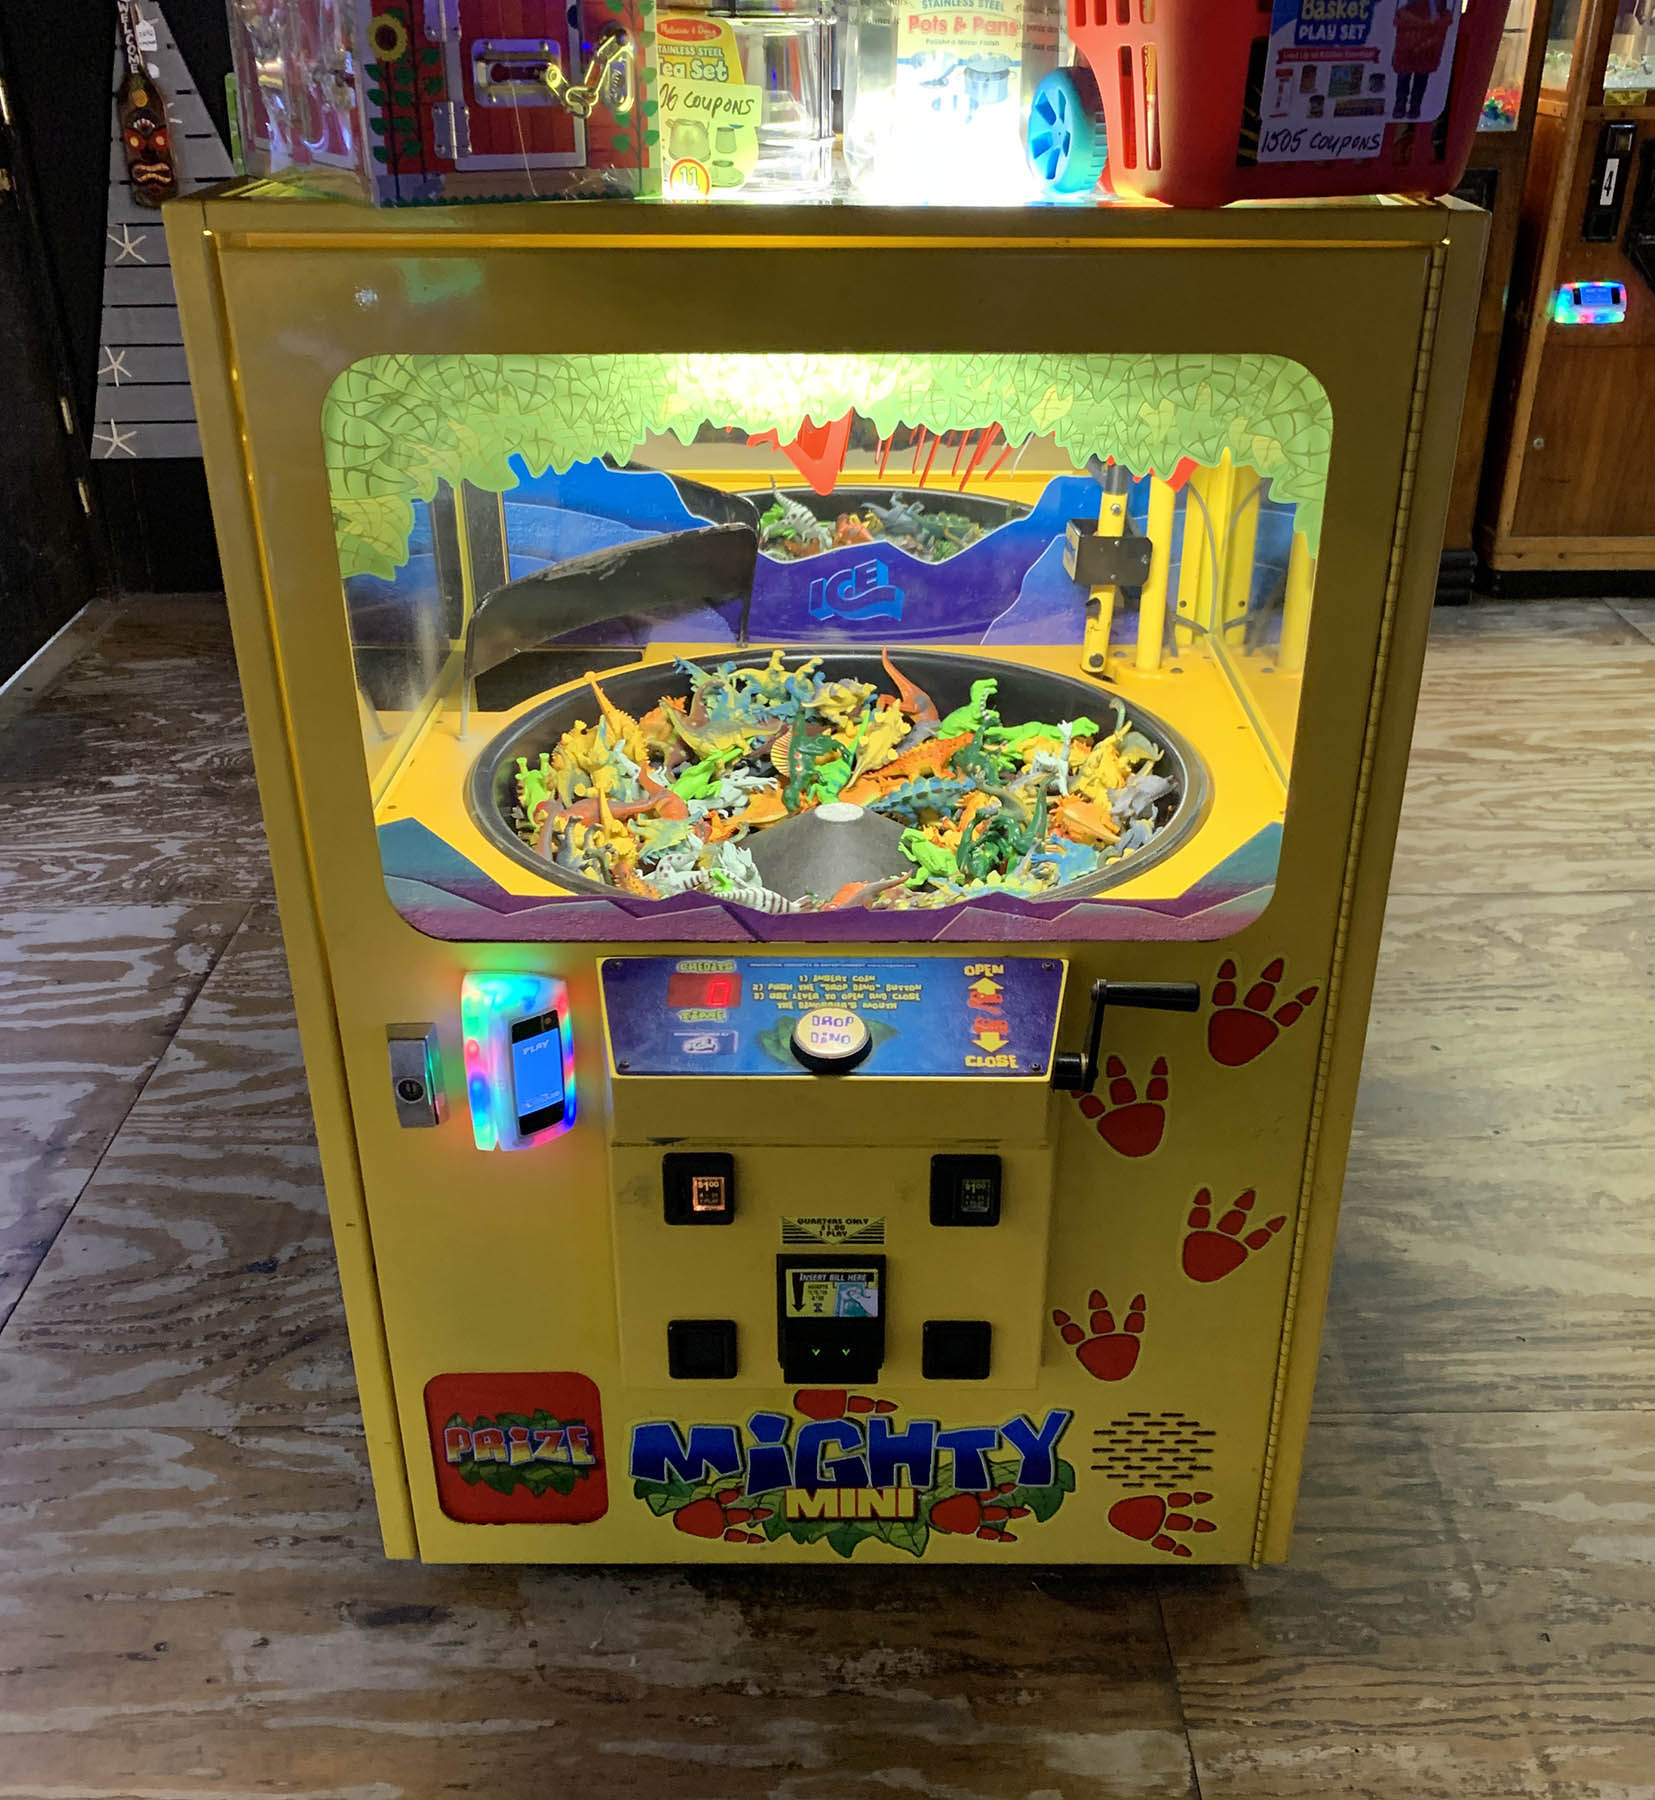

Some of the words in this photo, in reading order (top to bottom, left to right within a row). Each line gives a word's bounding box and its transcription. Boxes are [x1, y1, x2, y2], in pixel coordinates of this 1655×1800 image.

[1301, 0, 1371, 20] Basket
[908, 15, 948, 34] Pots
[953, 15, 966, 33] &
[972, 15, 1018, 36] Pans
[1299, 24, 1337, 41] PLAY
[1339, 23, 1367, 40] SET
[117, 0, 140, 74] WELCOME
[658, 46, 696, 56] TAINLESS
[698, 47, 724, 57] STEEL
[690, 58, 729, 82] Set
[684, 91, 755, 118] COUPONS
[1261, 128, 1308, 153] 1505
[1603, 170, 1614, 197] 4
[808, 559, 904, 621] ICE
[964, 963, 1004, 977] OPEN
[812, 1015, 855, 1028] DROP
[523, 1039, 550, 1056] PLAY
[965, 1054, 1019, 1069] CLOSE
[800, 1273, 827, 1281] INSERT
[786, 1487, 916, 1520] MINI
